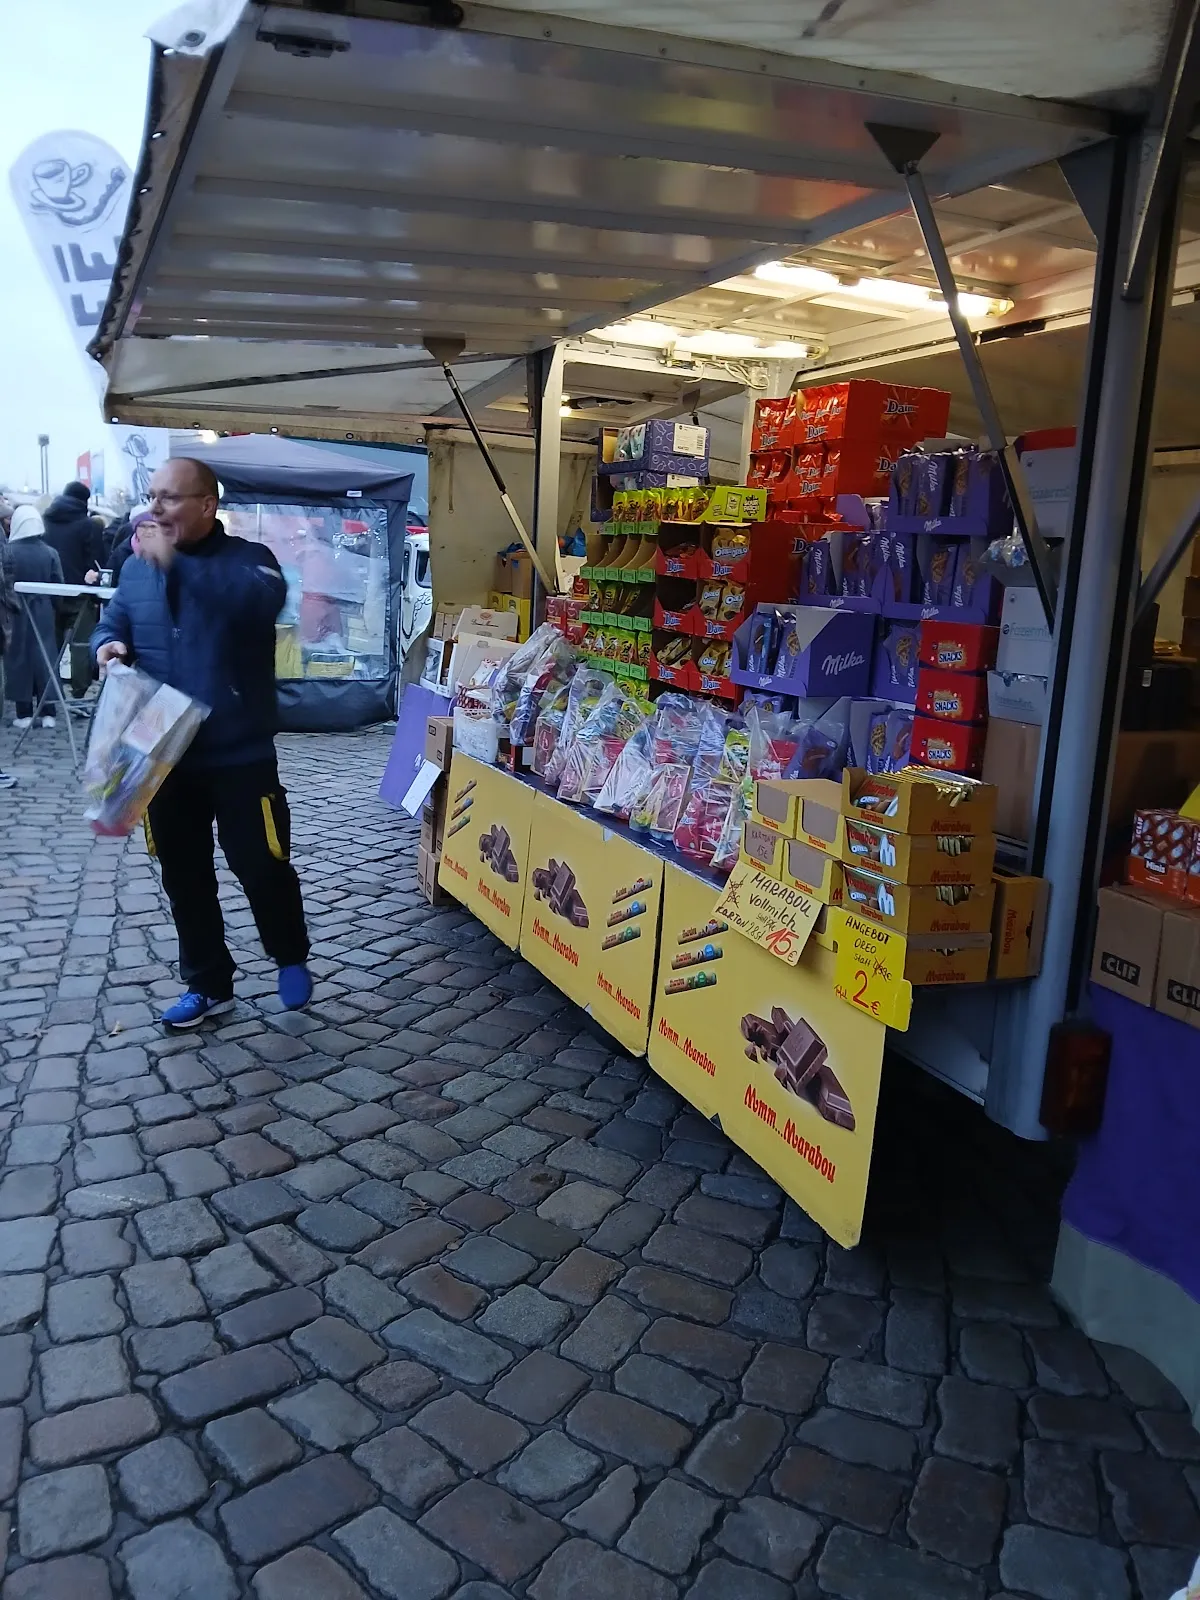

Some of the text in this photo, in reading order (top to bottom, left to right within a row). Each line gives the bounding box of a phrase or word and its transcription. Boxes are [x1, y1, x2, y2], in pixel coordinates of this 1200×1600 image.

[886, 398, 917, 414] Daim
[878, 457, 897, 472] Da
[939, 651, 963, 662] SNACKS
[821, 651, 865, 677] Milka
[934, 701, 958, 711] SNACKS
[928, 749, 952, 760] SNACKS
[930, 820, 972, 833] Marabou
[930, 870, 972, 883] Marabou
[750, 872, 813, 918] MARABOU
[749, 893, 797, 932] Vollmilch
[845, 915, 892, 944] ANGEBOT
[930, 919, 971, 931] Marabou
[854, 938, 877, 954] OREO
[854, 953, 871, 966] statt
[1106, 957, 1136, 980] CLIF
[925, 970, 966, 982] Marabou
